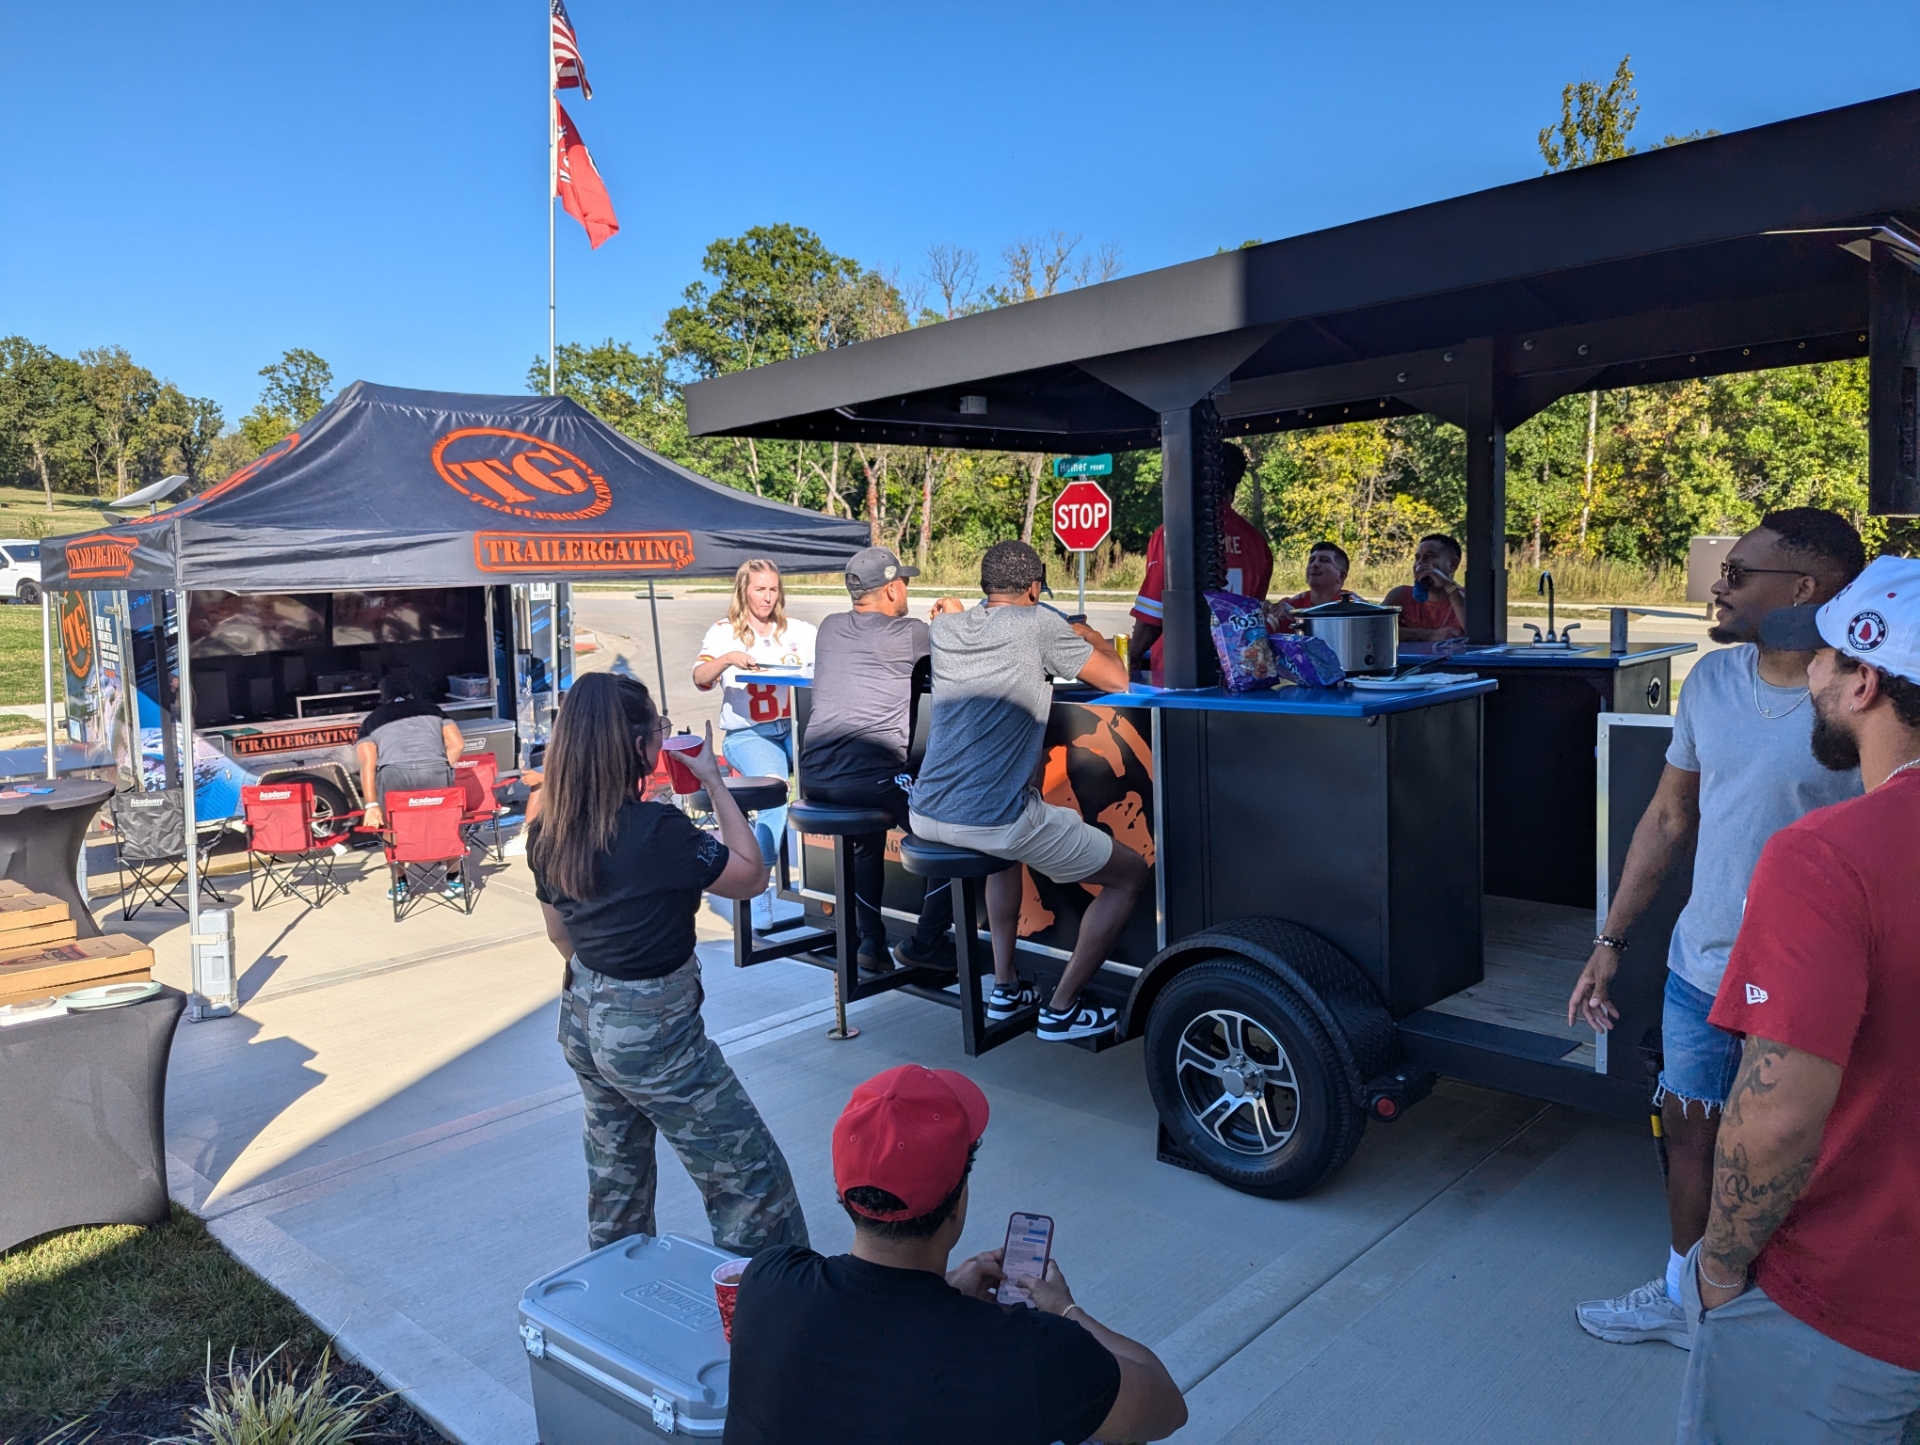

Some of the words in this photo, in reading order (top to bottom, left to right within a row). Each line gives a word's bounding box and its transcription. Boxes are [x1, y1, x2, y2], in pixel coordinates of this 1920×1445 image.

[446, 449, 589, 504] TG
[1057, 502, 1107, 530] STOP
[484, 539, 685, 563] TRAILERGATING
[238, 728, 358, 753] TRAILERGATING
[260, 790, 293, 799] Academy
[409, 797, 446, 805] Academy
